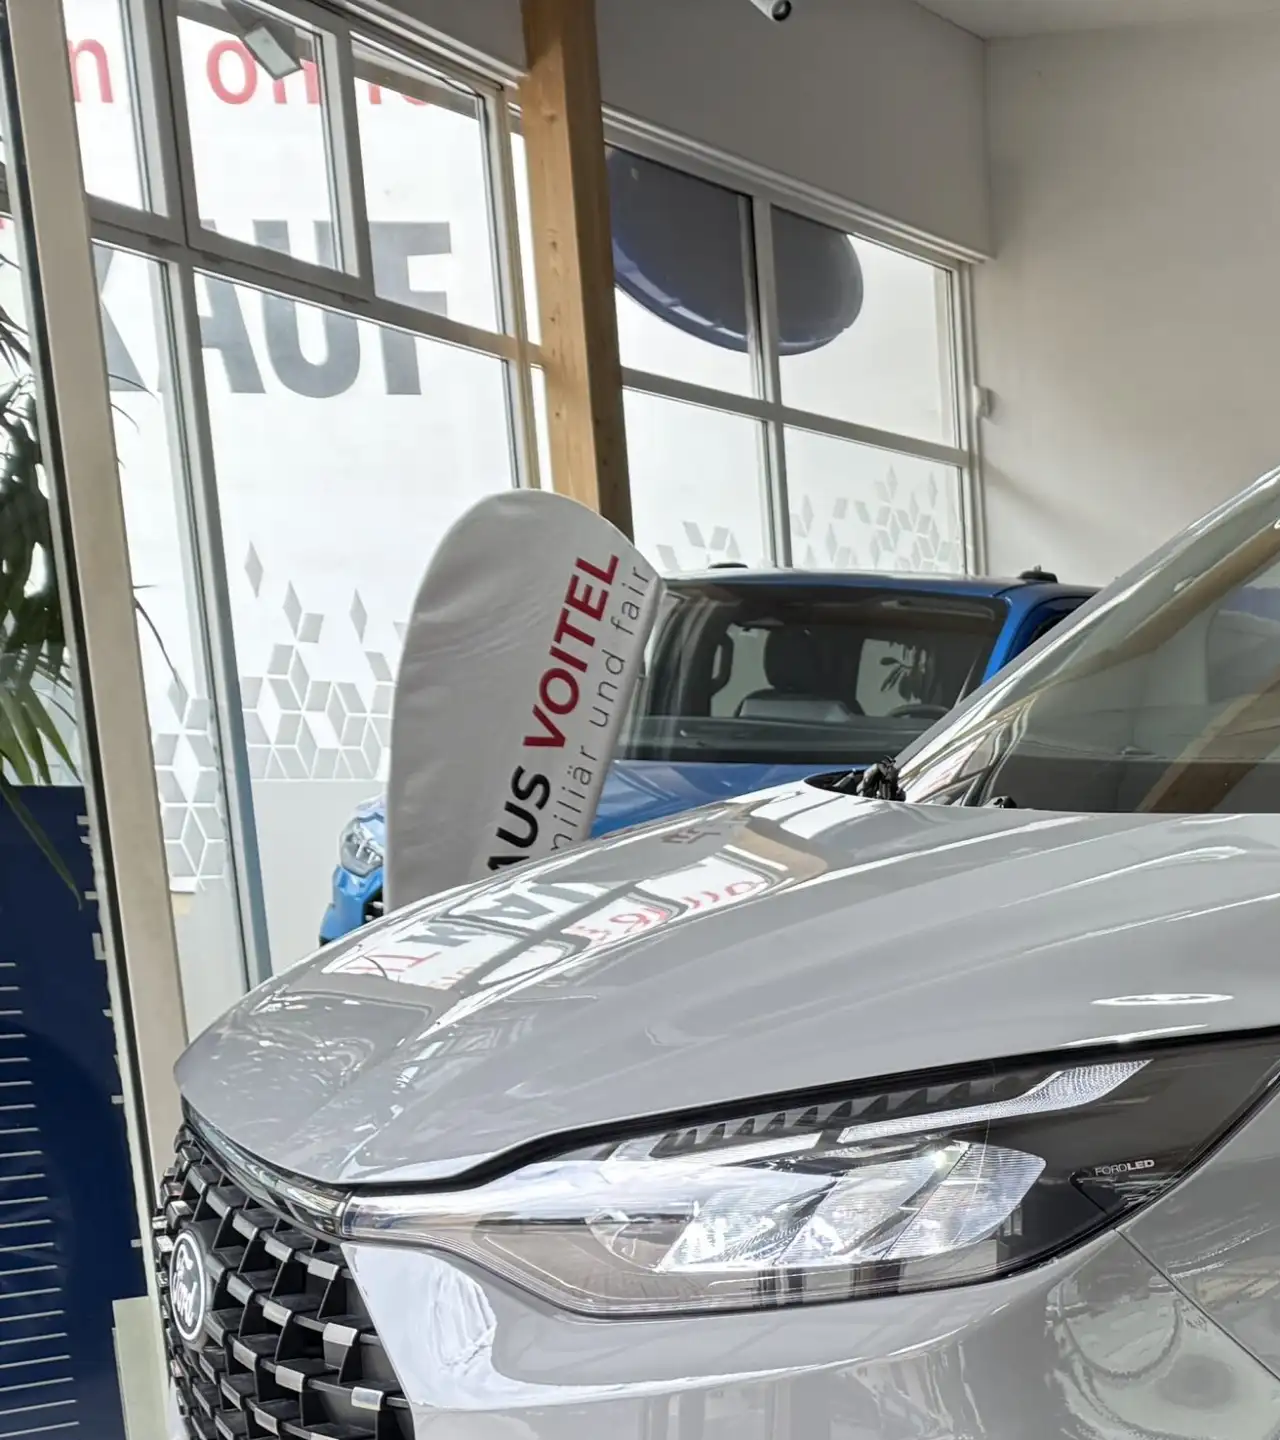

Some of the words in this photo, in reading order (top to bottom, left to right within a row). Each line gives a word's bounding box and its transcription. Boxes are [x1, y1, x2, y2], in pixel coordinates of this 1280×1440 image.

[522, 554, 620, 748] VOITEL
[589, 648, 626, 728] und
[610, 566, 649, 636] fair
